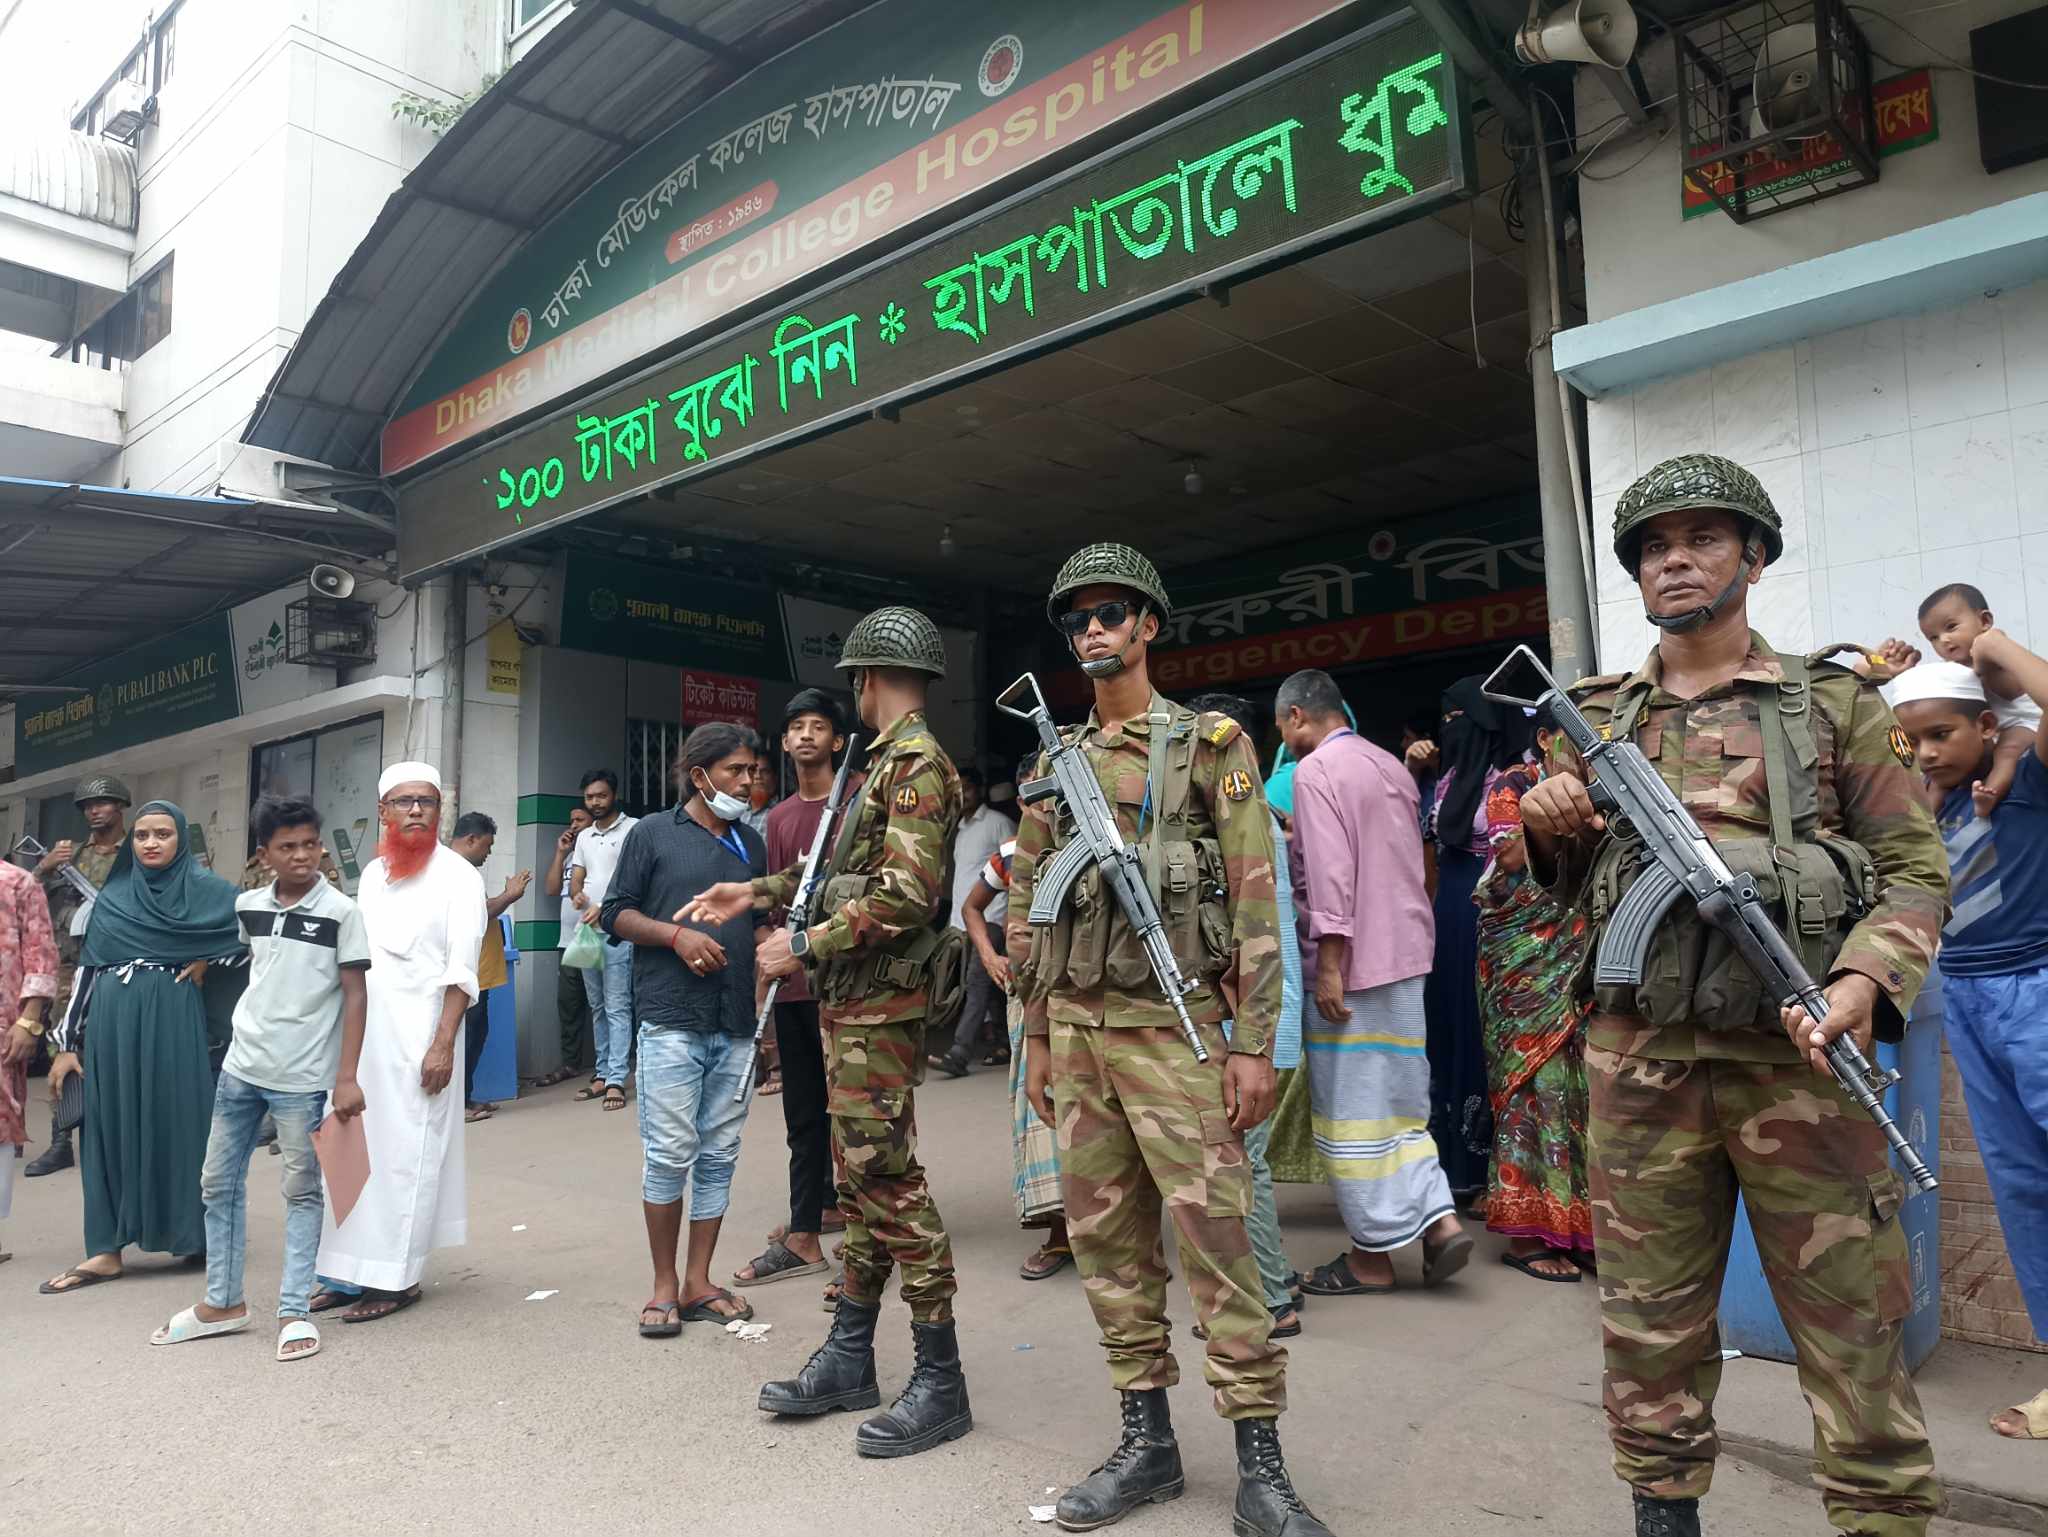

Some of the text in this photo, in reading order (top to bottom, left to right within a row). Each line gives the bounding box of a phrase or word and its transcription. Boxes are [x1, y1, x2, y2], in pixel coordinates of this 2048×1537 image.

[436, 369, 532, 435] Dhaka
[706, 179, 894, 297] College
[916, 5, 1204, 193] Hospital
[540, 74, 961, 328] ঢাকা মেডিকেল কলেজ হাসপাতাল
[678, 220, 714, 253] স্থাপিত
[728, 195, 762, 226] ১৯৪৬
[496, 457, 565, 510] ১০০
[575, 398, 660, 481] টাকা
[668, 353, 760, 462] বুঝে
[769, 315, 862, 413] নিন
[923, 118, 1302, 344] হাসপাতালে
[118, 675, 155, 705] PUBALI
[158, 660, 191, 692] BANK
[1158, 622, 1373, 681] ergency
